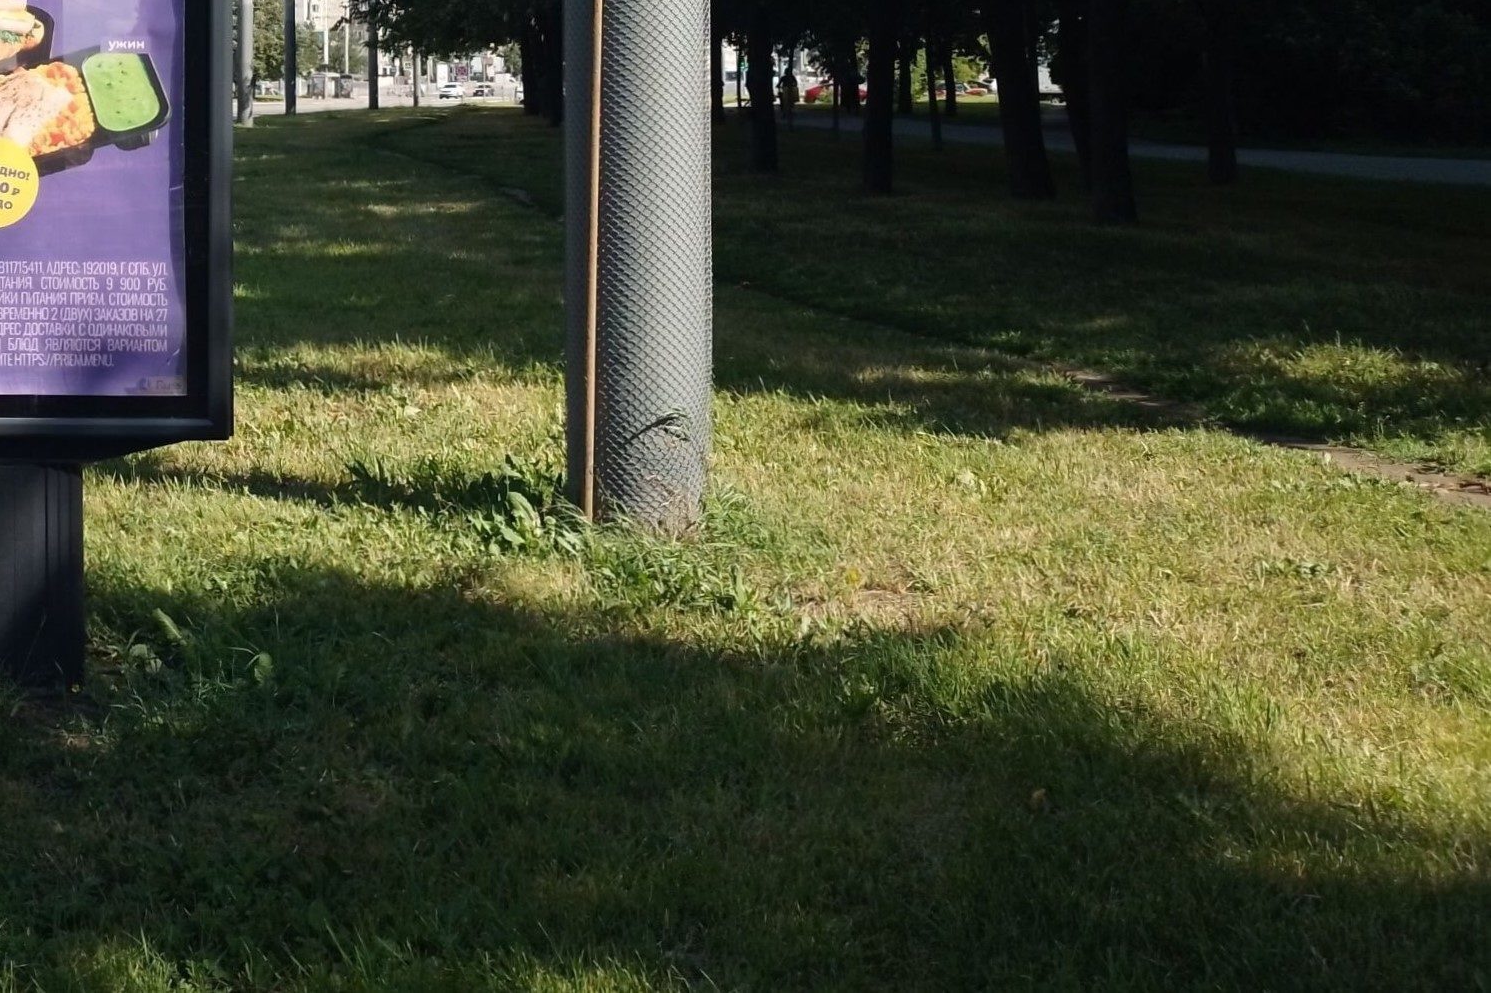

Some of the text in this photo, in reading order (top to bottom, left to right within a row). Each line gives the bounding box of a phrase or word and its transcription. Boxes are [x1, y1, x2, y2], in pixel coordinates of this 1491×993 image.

[108, 40, 145, 52] ужин
[41, 277, 100, 290] СТОИМОСТЬ
[120, 277, 141, 291] 900
[21, 292, 67, 305] ПИТАНИЯ
[108, 293, 168, 306] СТОИМОСТЬ
[60, 308, 92, 321] (ДВУХ)
[95, 308, 138, 321] ЗАКАЗОВ
[88, 323, 168, 336] ОДИНАКОВЫМИ
[8, 338, 38, 351] БЛЮД
[45, 338, 101, 351] ЯВЛЯЮТСЯ
[107, 338, 168, 351] ВАРИАНТОМ
